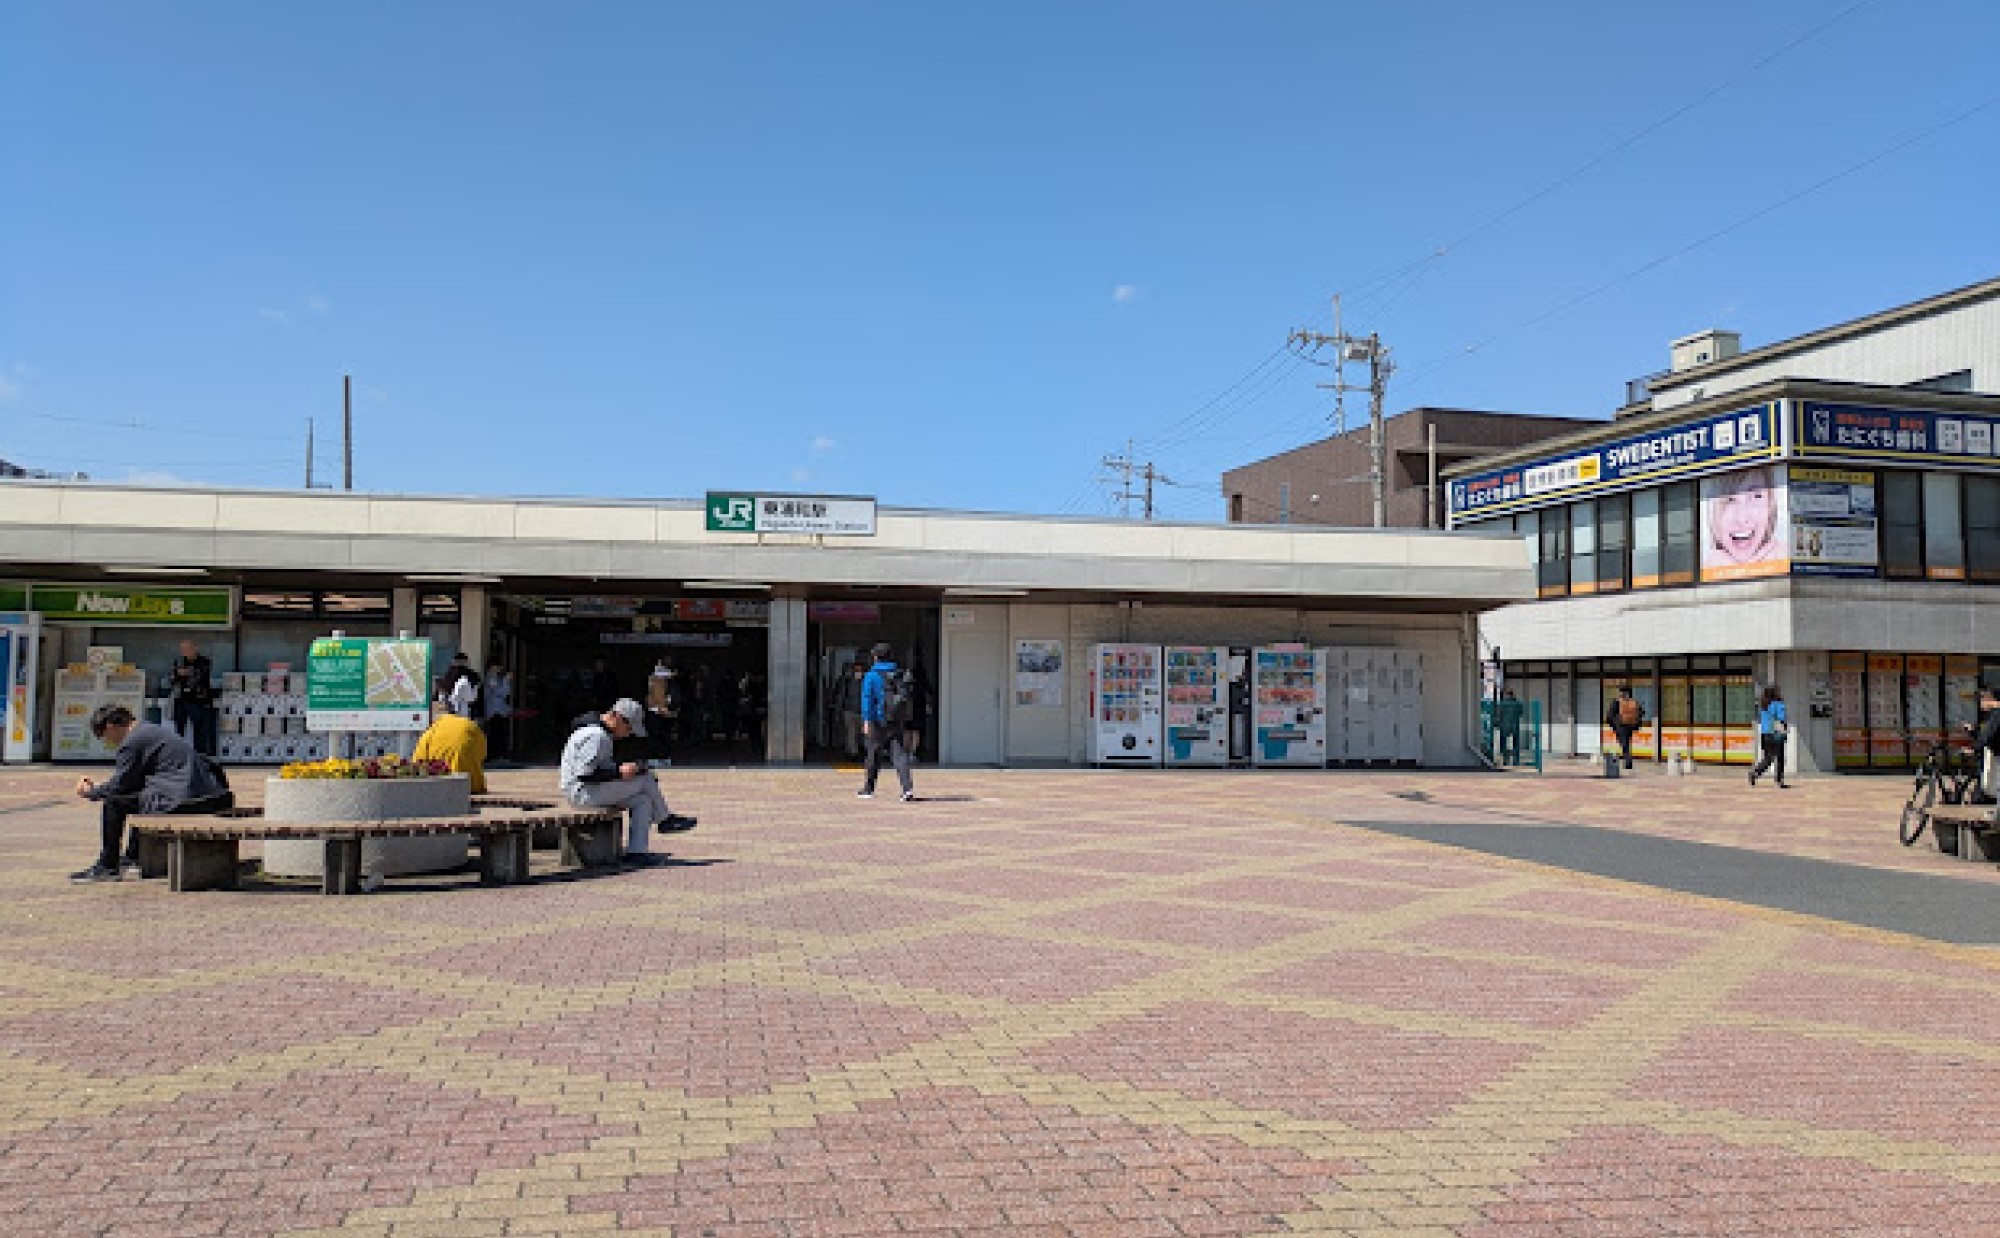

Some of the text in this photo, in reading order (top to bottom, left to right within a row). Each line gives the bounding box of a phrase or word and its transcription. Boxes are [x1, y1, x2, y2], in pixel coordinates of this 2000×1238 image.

[1606, 427, 1709, 469] SWEDENTIST
[713, 498, 752, 521] JR
[77, 591, 185, 616] NewDays
